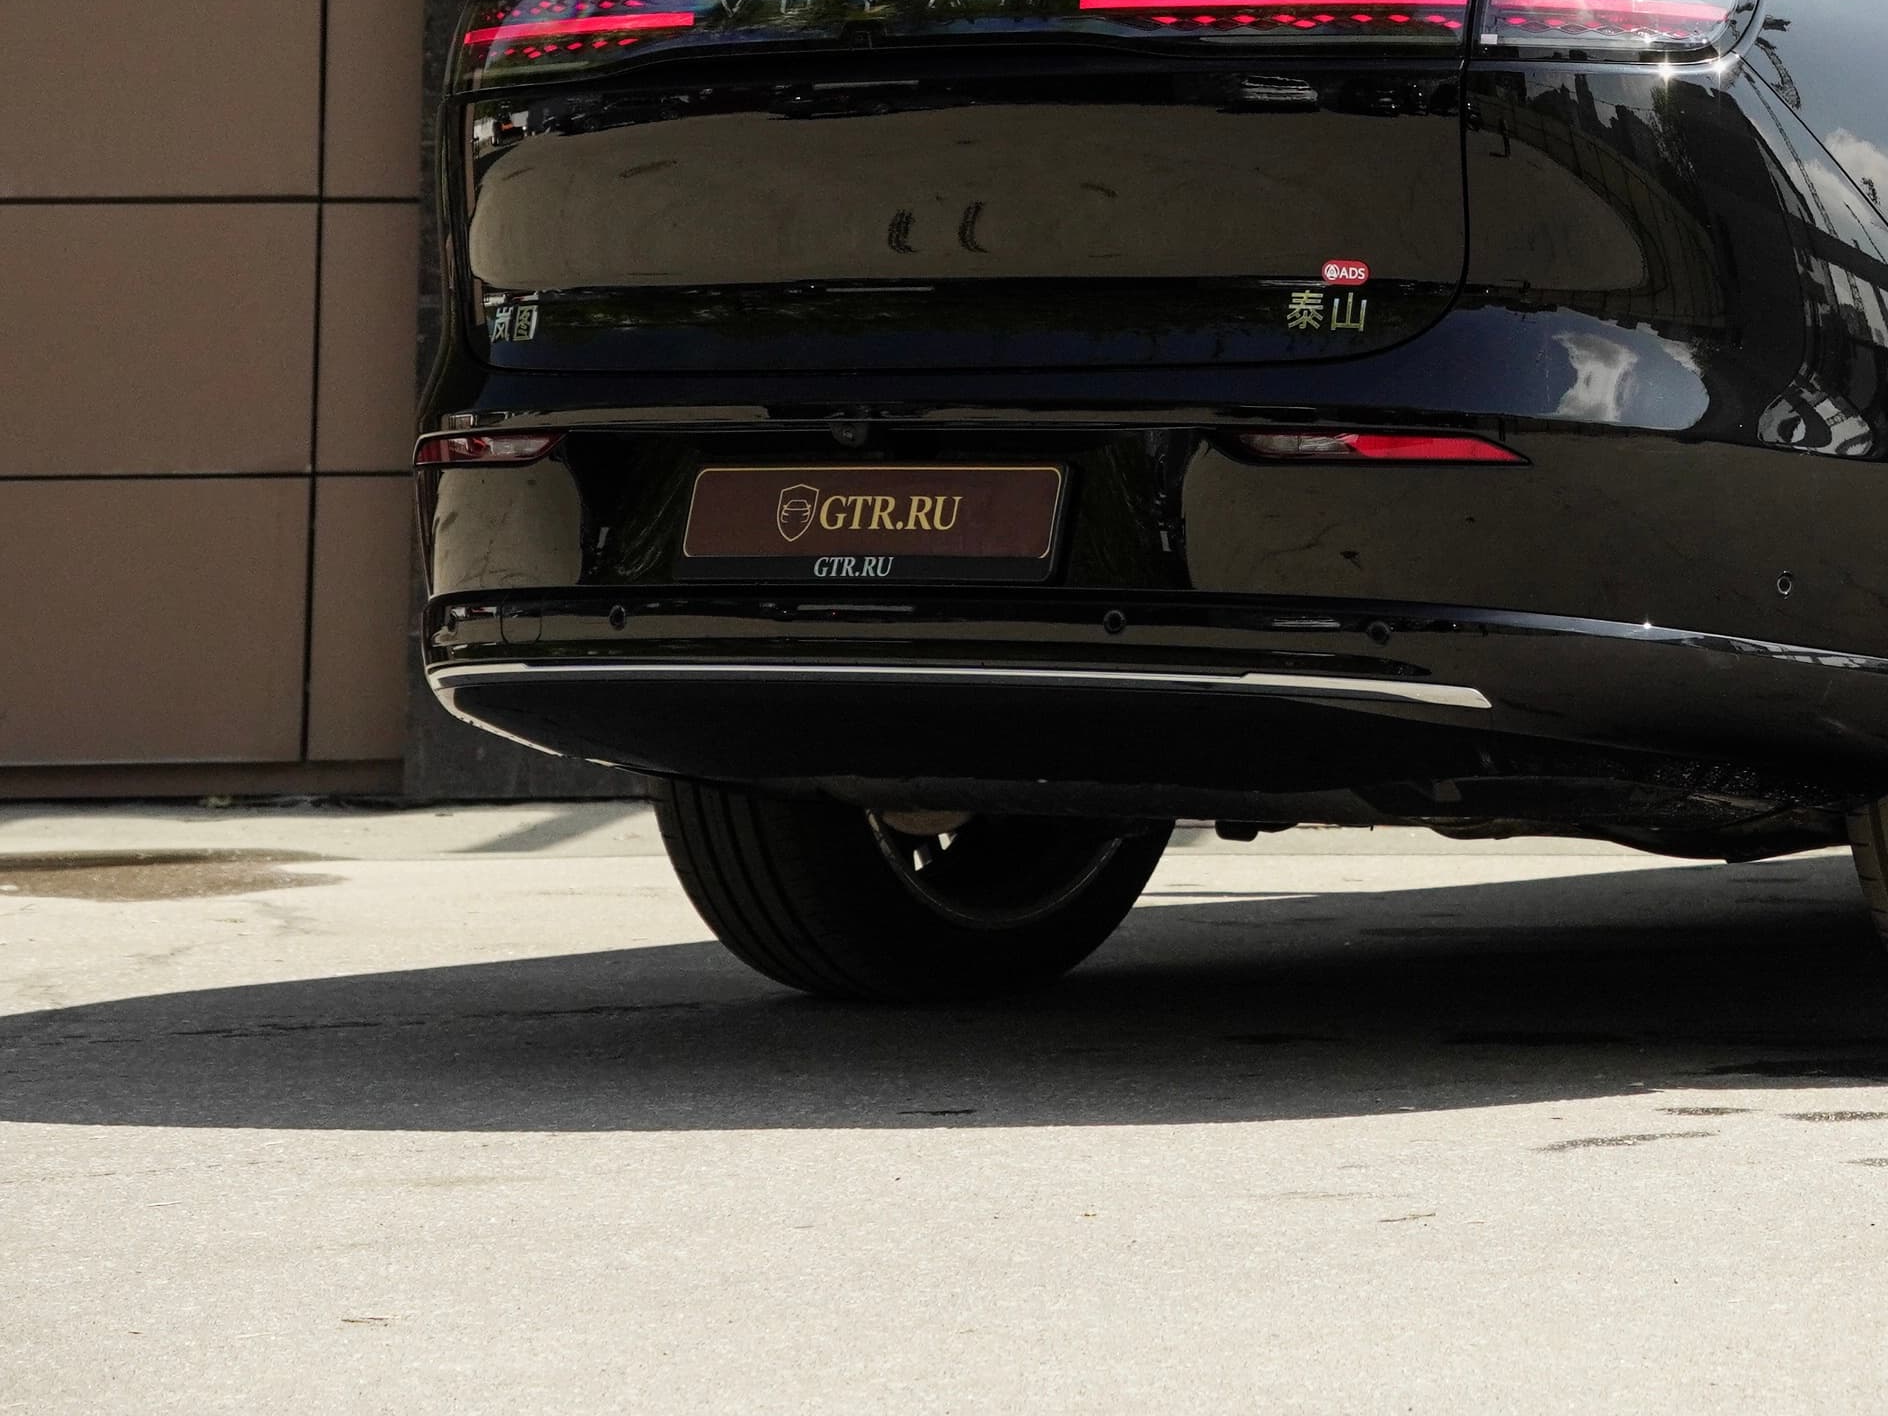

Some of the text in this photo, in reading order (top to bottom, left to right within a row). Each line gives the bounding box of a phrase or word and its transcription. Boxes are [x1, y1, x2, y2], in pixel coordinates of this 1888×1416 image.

[1339, 267, 1366, 280] ADS
[1286, 289, 1368, 332] 泰山
[819, 495, 963, 531] GTR.RU
[813, 555, 894, 578] GTR.RU
